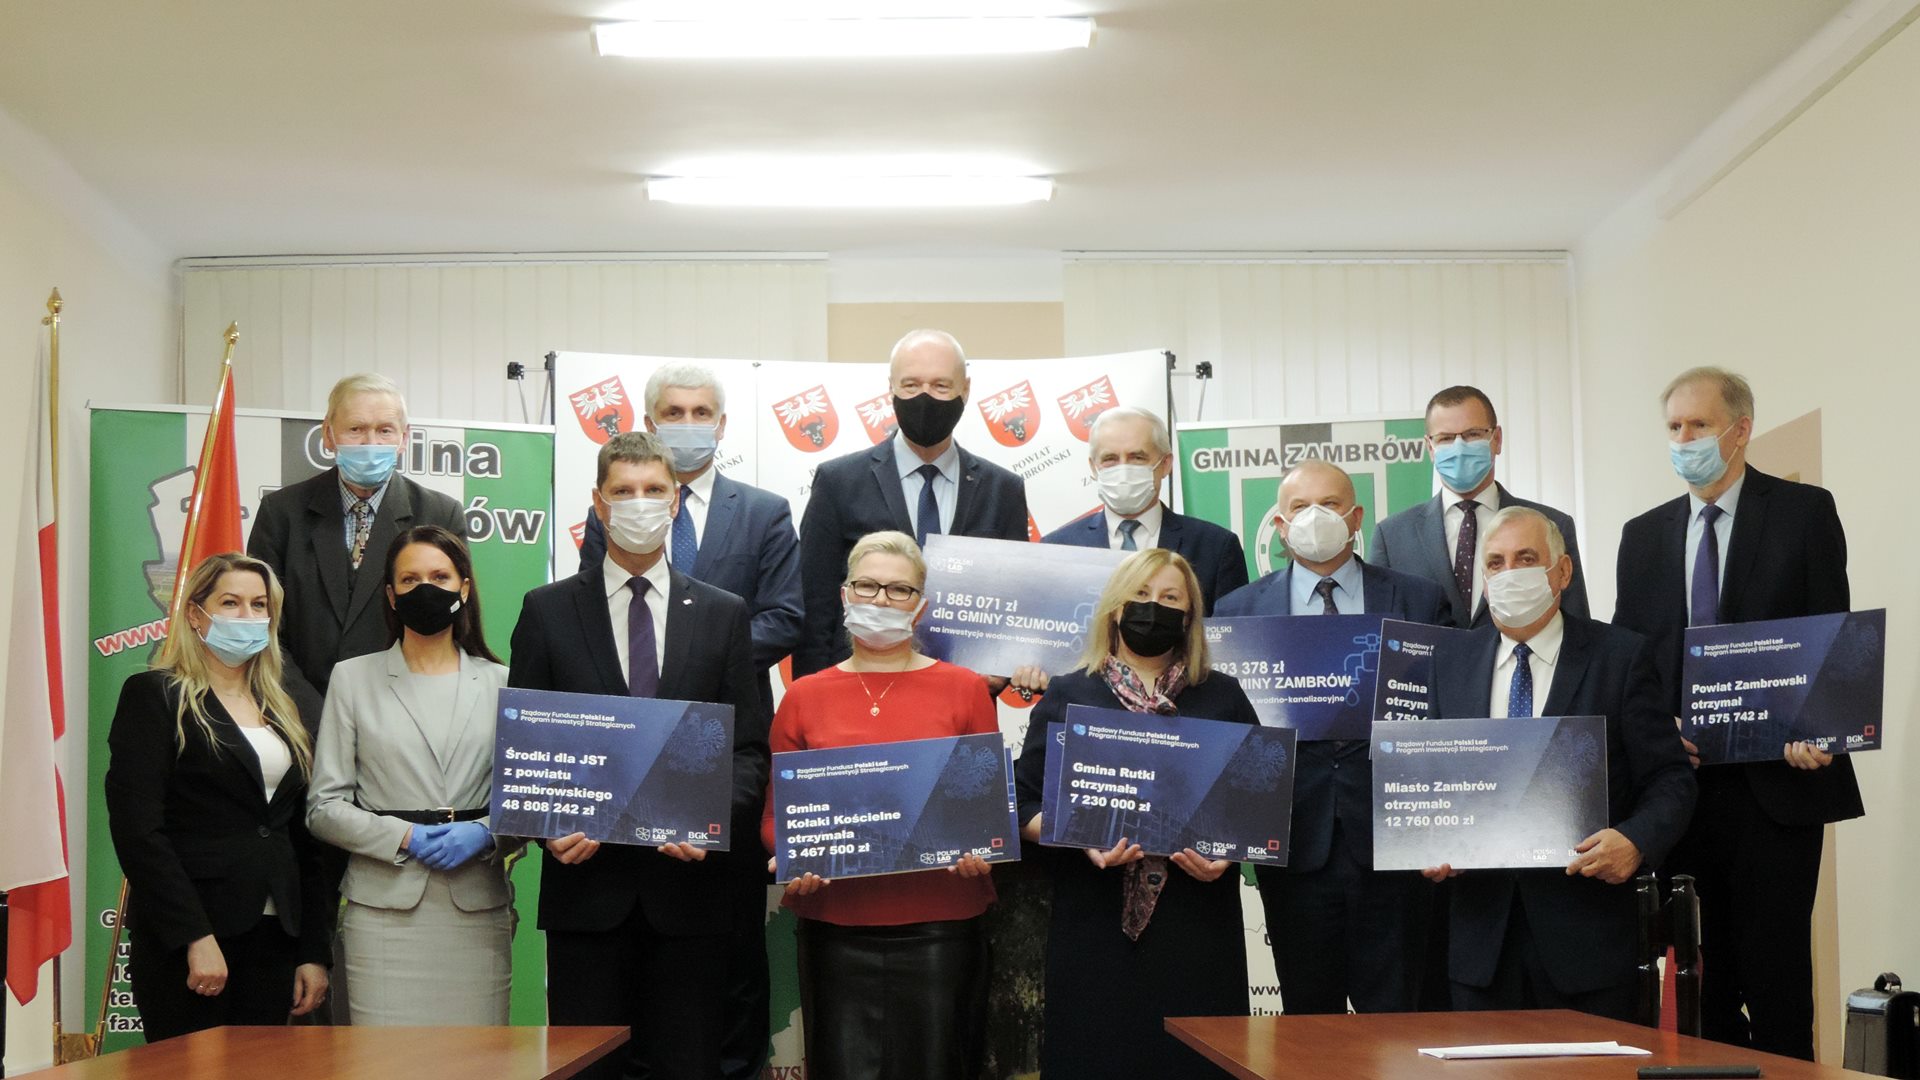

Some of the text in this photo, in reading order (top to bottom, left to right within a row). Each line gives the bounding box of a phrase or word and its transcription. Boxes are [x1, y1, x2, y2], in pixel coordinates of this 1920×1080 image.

[305, 424, 501, 478] Gina
[1194, 438, 1424, 470] GMINA ZAMBRÓW
[1012, 446, 1051, 472] POWIAT
[935, 592, 1018, 613] 1 885 071 zł
[932, 607, 1079, 634] dla GMINY SZUMOWO
[942, 626, 984, 639] inwestycje
[985, 631, 1070, 648] wodno-kanalizacyjne
[1242, 661, 1269, 674] 378
[1273, 660, 1285, 674] zł
[1239, 673, 1352, 690] MINY ZAMBRÓW
[1387, 679, 1428, 694] Gmina
[1692, 674, 1807, 694] Powiat Zambrowski
[1256, 694, 1345, 705] wodno-kanalizacyjne
[1386, 696, 1428, 710] otrzym
[1691, 696, 1742, 711] otrzymał
[521, 709, 551, 718] Rządowy
[552, 711, 579, 719] Fundusz
[580, 713, 601, 721] Polski
[1384, 711, 1393, 720] 4
[1691, 710, 1768, 725] 11 575 742 zł
[520, 716, 635, 730] Program Inwestycji Strategicznych
[1088, 731, 1117, 742] Program
[1150, 737, 1200, 749] Strategicznych
[1118, 728, 1146, 738] Fundusz
[1146, 731, 1166, 739] Polski
[1846, 735, 1864, 743] BGK
[1395, 746, 1425, 754] Program
[1459, 744, 1509, 753] Strategicznych
[505, 747, 607, 766] Środki dla JST
[854, 761, 874, 769] Polski
[1072, 762, 1155, 781] Gmina Rutki
[504, 767, 571, 781] z powiatu
[797, 770, 826, 780] Program
[502, 783, 613, 801] zambrowskiego
[1071, 779, 1138, 795] otrzymała
[1384, 780, 1498, 793] Miasto Zambrów
[502, 799, 595, 816] 48 808 242 zł
[786, 802, 830, 815] Gmina
[1069, 793, 1151, 812] 7 230 000 zł
[1384, 799, 1451, 811] otrzymało
[787, 810, 901, 829] Kołaki Kościelne
[1385, 814, 1475, 827] 12 760 000 zł
[652, 828, 677, 836] POLSKI
[688, 831, 708, 840] BGK
[787, 829, 854, 846] otrzymała
[788, 842, 871, 859] 3 467 500 zł
[972, 847, 992, 855] BGK
[1212, 842, 1237, 850] POLSKI
[1247, 846, 1267, 855] BGK
[936, 854, 952, 863] ŁAD
